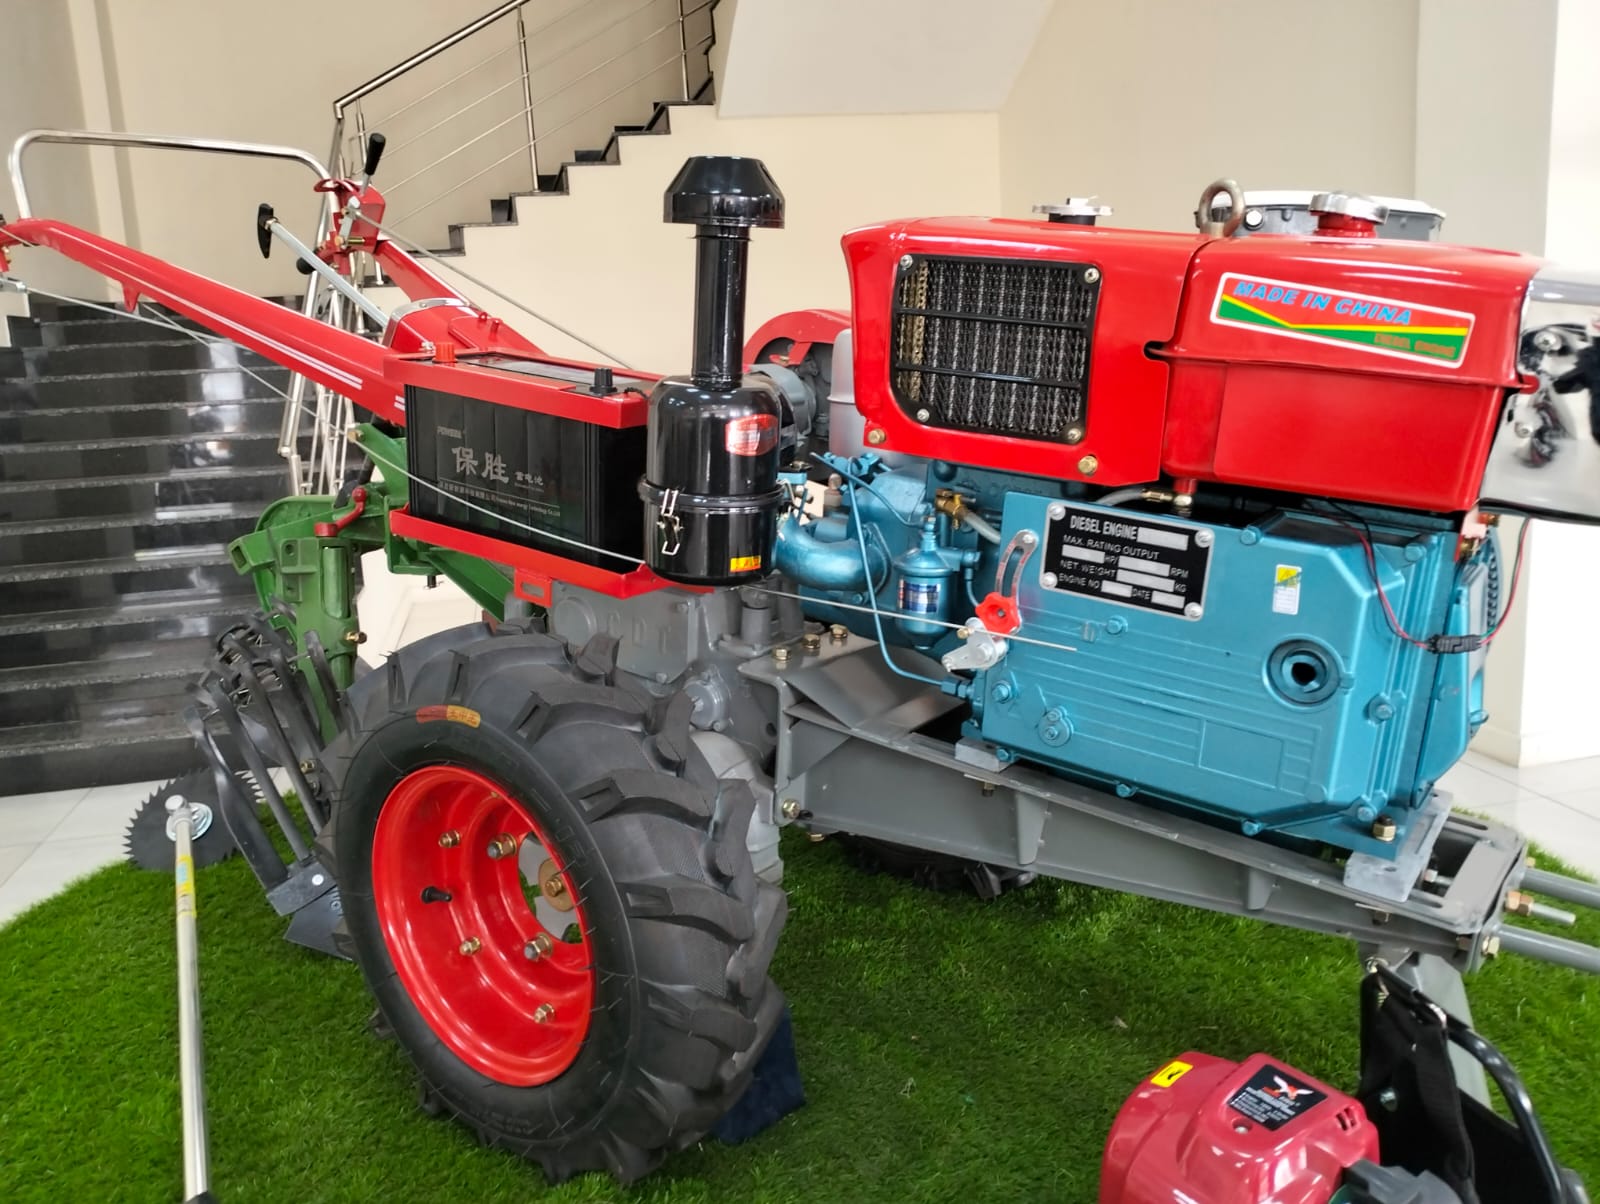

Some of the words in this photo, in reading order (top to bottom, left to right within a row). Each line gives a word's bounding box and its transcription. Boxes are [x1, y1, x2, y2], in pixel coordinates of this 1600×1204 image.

[1233, 282, 1299, 305] MADE
[1303, 293, 1332, 311] IN
[1335, 298, 1412, 325] CHINA
[1069, 515, 1101, 534] DIESEL
[1102, 521, 1138, 540] ENGINE
[1063, 534, 1085, 545] MAX.
[1086, 538, 1121, 553] RATING
[1122, 546, 1160, 560] OUTPUT
[1058, 573, 1087, 586] ENGINE
[1132, 588, 1151, 599] DATE
[1060, 559, 1079, 570] NET
[1081, 563, 1116, 577] WEIGHT
[1174, 583, 1187, 593] KG
[1170, 567, 1189, 579] RPM
